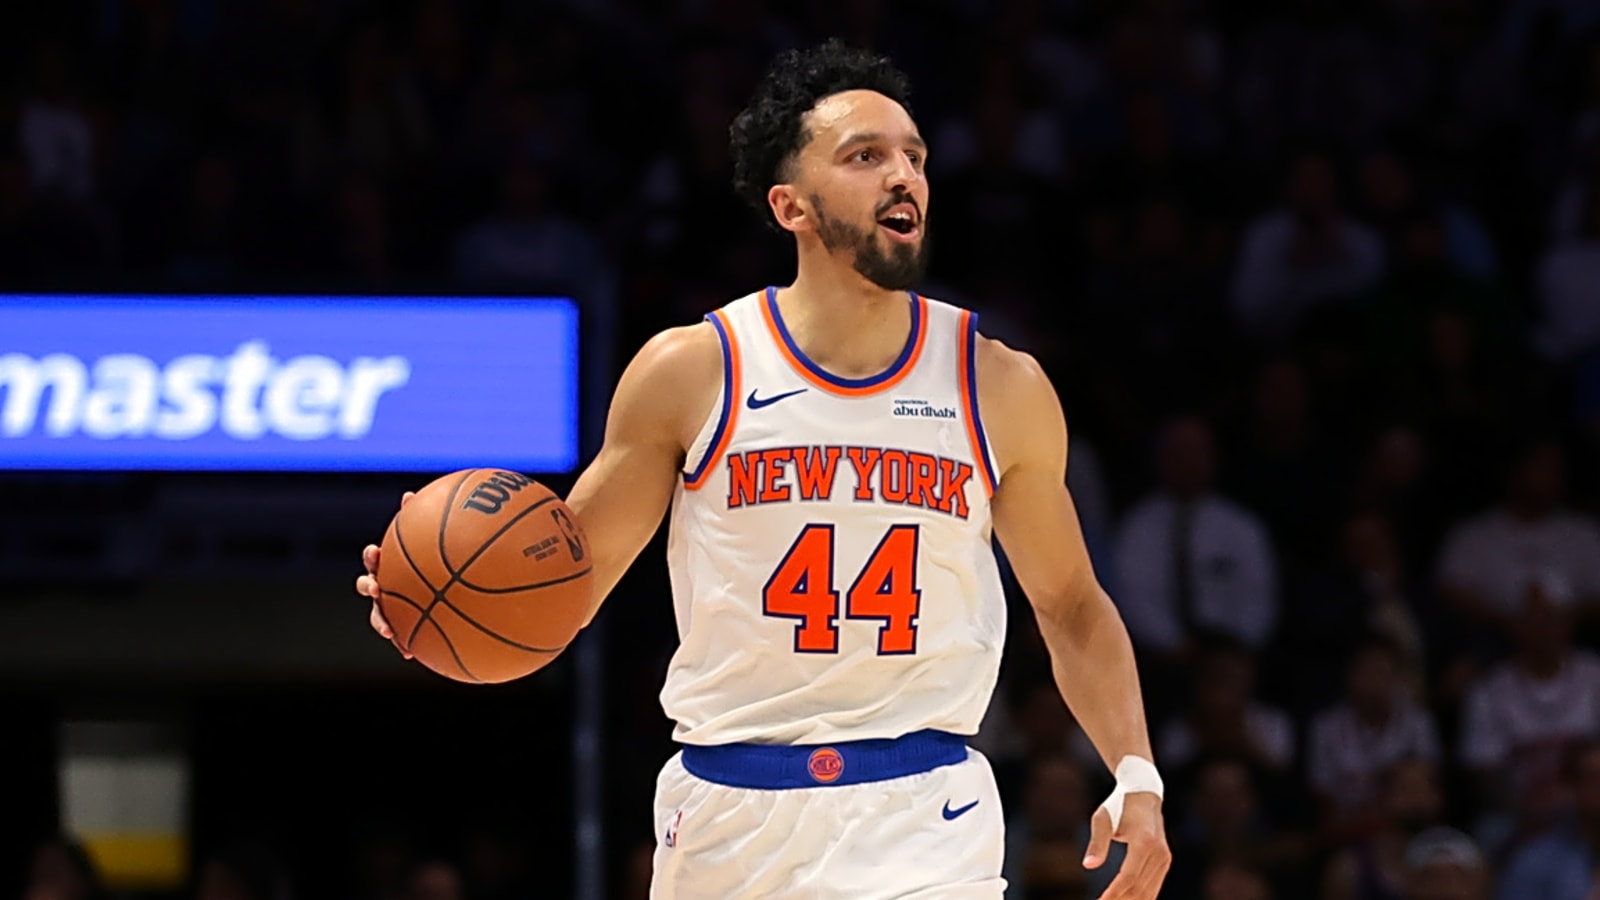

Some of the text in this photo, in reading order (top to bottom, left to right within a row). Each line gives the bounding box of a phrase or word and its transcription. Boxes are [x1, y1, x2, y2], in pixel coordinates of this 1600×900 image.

[0, 338, 412, 441] master
[893, 405, 957, 419] abu dhabi
[727, 445, 974, 521] NEW YORK
[762, 523, 922, 656] 44
